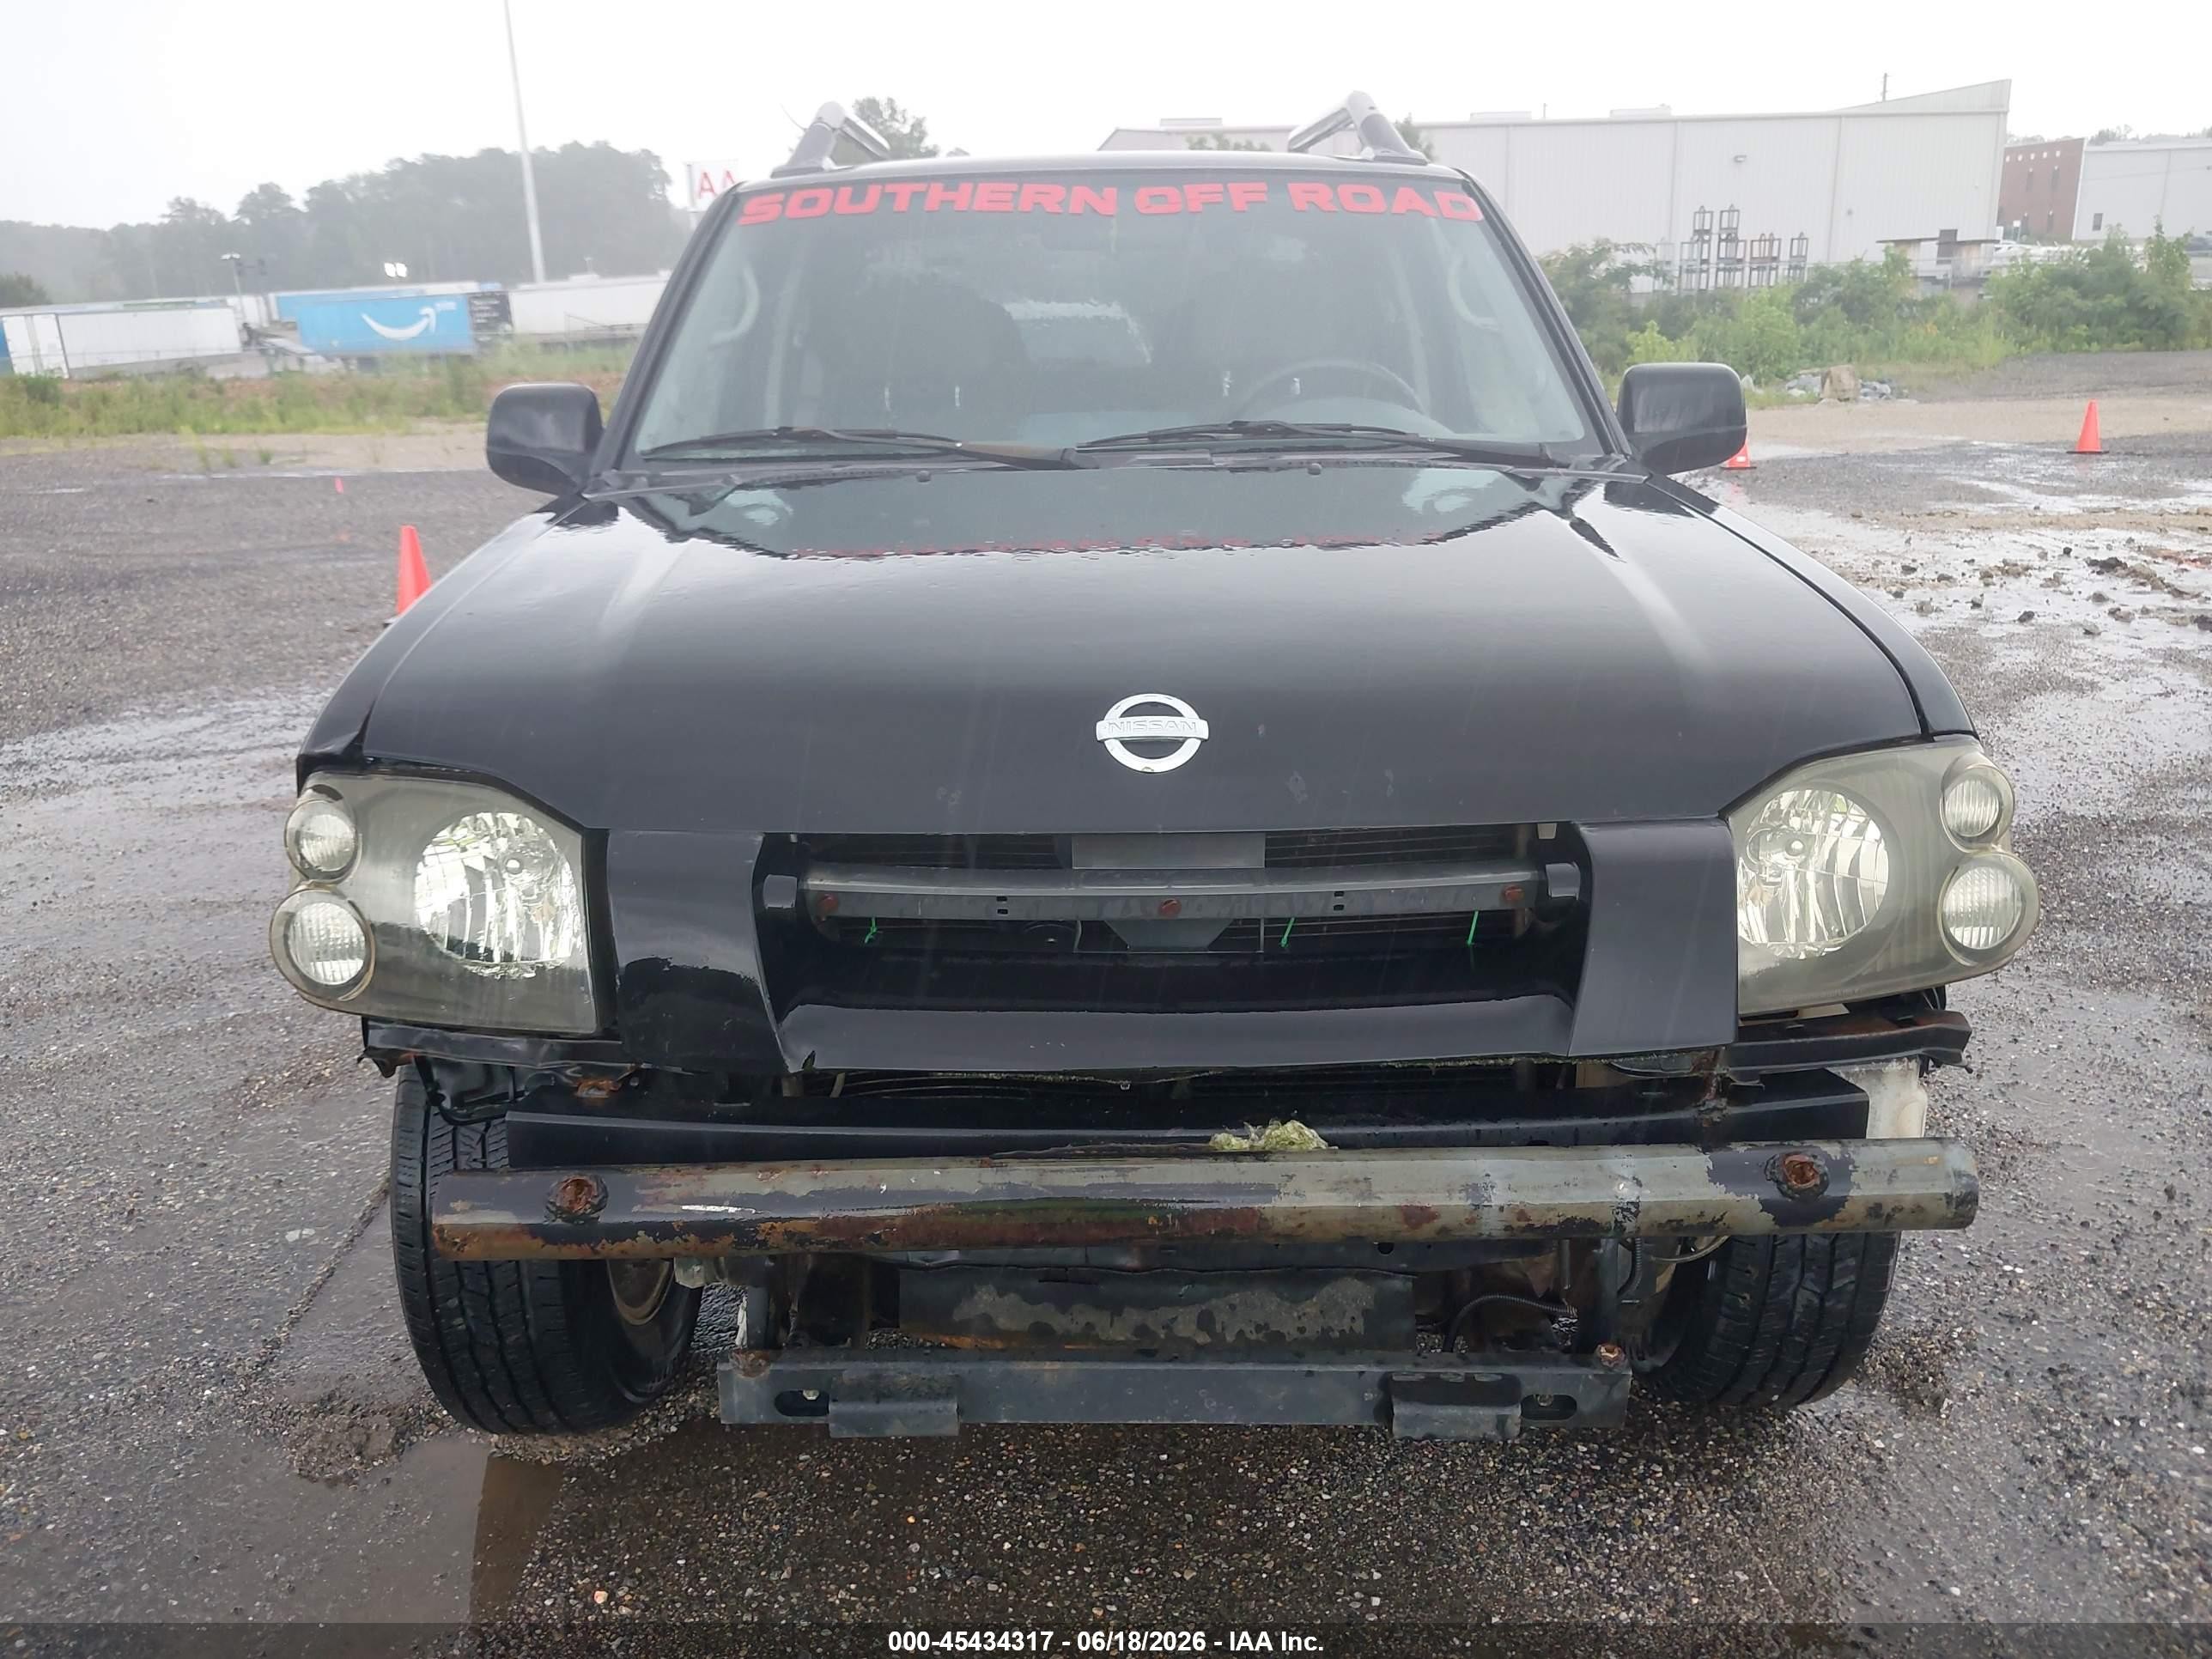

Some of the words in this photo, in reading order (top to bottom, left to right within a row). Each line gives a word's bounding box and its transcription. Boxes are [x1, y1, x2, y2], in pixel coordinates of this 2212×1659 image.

[737, 182, 1117, 225] SOUTHERN
[1134, 182, 1268, 215] OFF
[1287, 182, 1484, 222] ROAD
[1108, 720, 1198, 734] NISSAN
